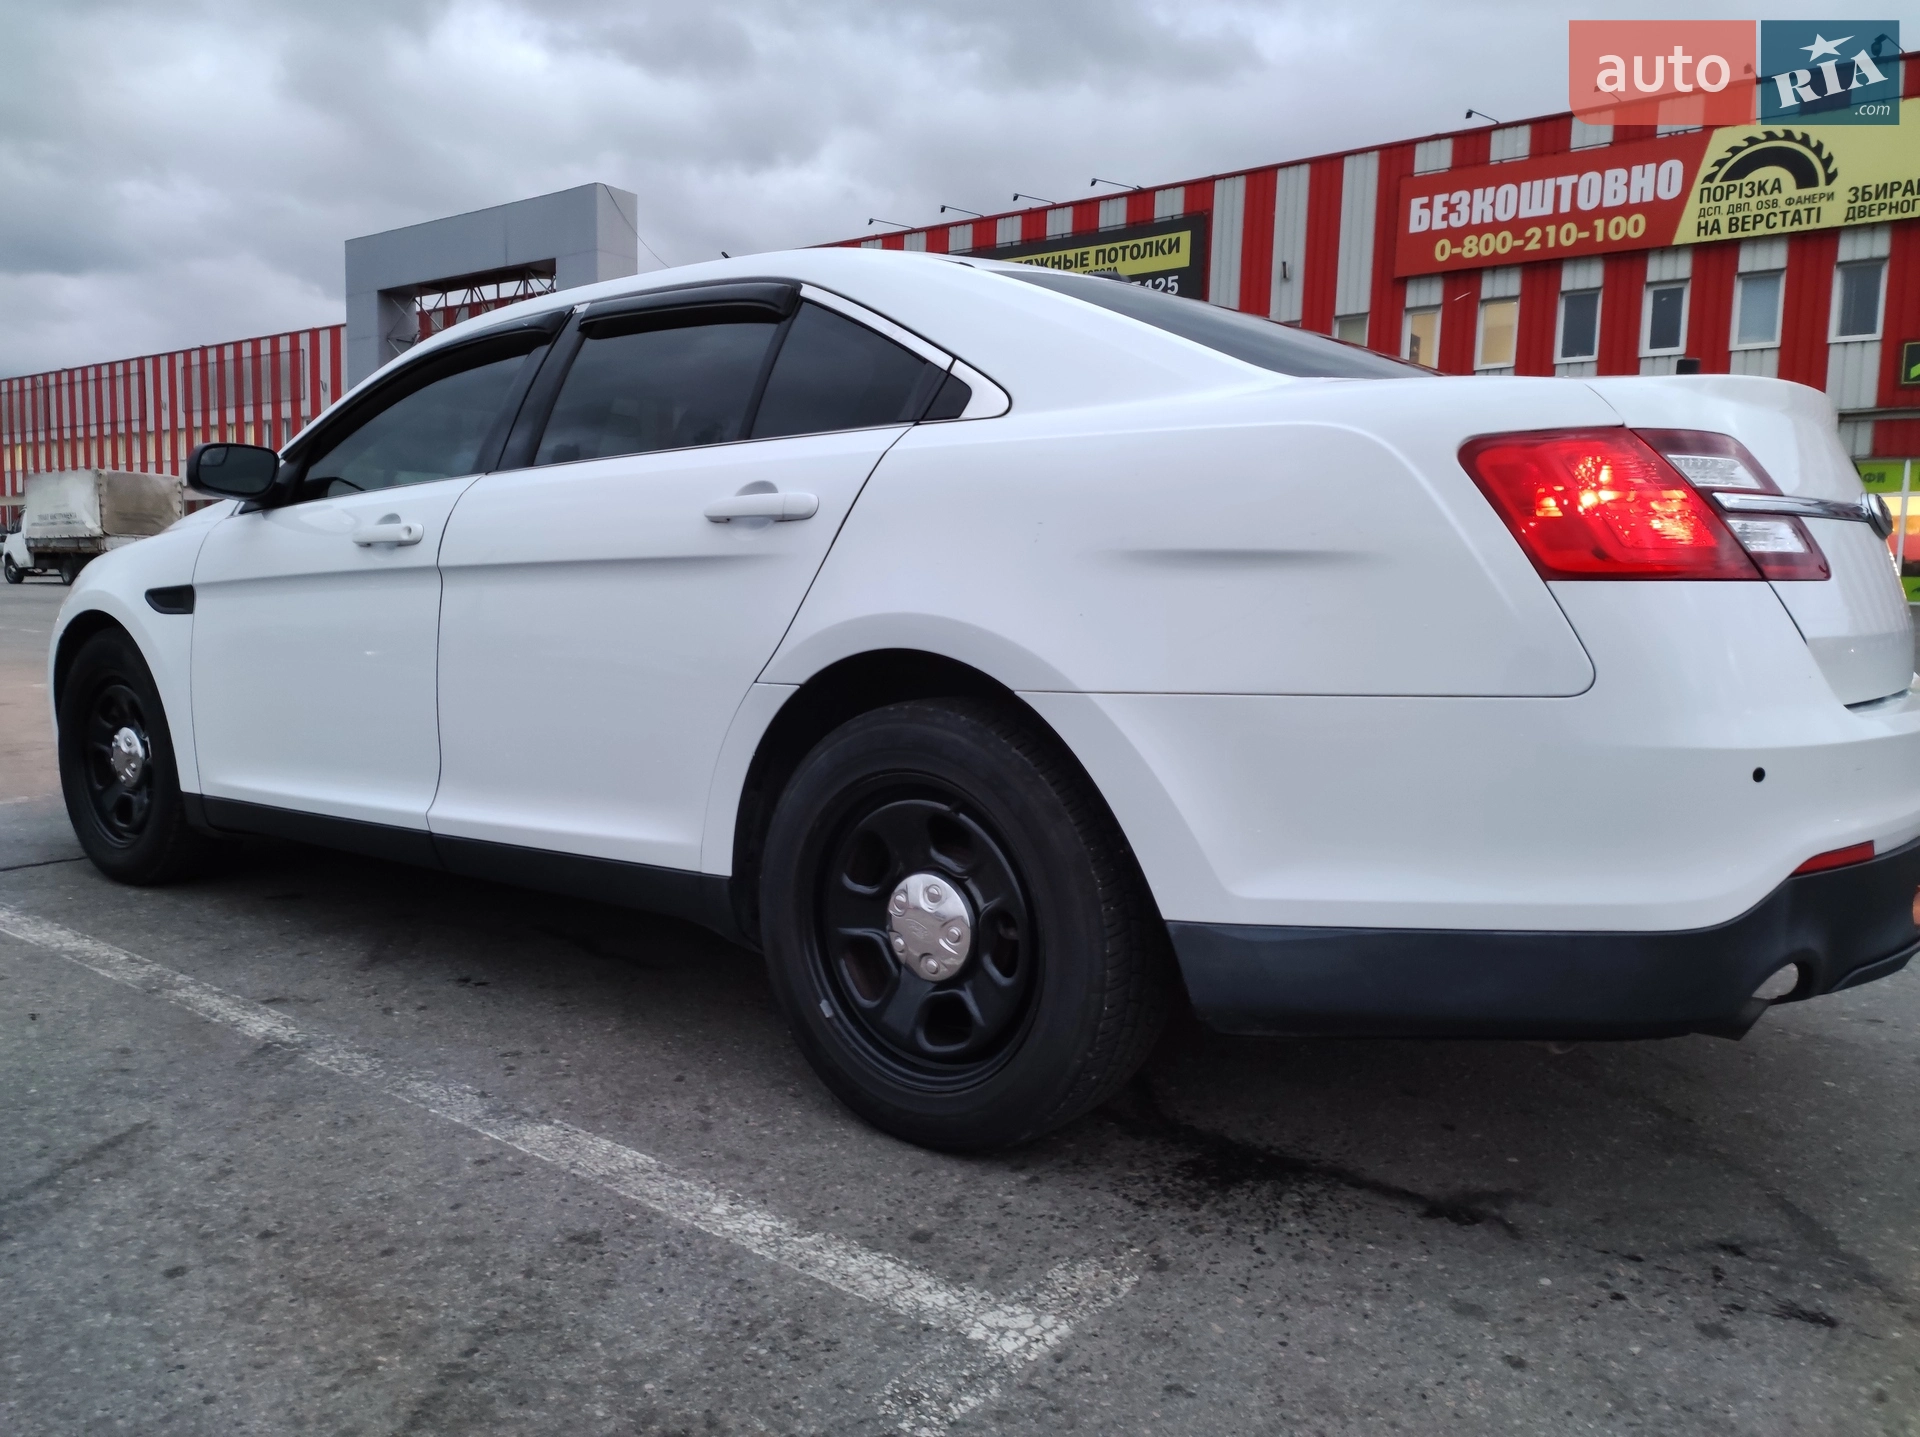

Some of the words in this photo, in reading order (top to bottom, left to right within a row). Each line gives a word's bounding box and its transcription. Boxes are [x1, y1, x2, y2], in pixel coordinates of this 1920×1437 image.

[1408, 159, 1684, 233] БЕЗКОШТОВНО
[1699, 177, 1783, 204] ПОРІЗКА
[1784, 191, 1835, 207] ФАНЕРИ
[1696, 218, 1722, 237] НА
[1727, 206, 1822, 234] ВЕРСТАТІ
[1094, 236, 1180, 265] ПОТОЛКИ
[1434, 213, 1647, 262] 0-800-210-100
